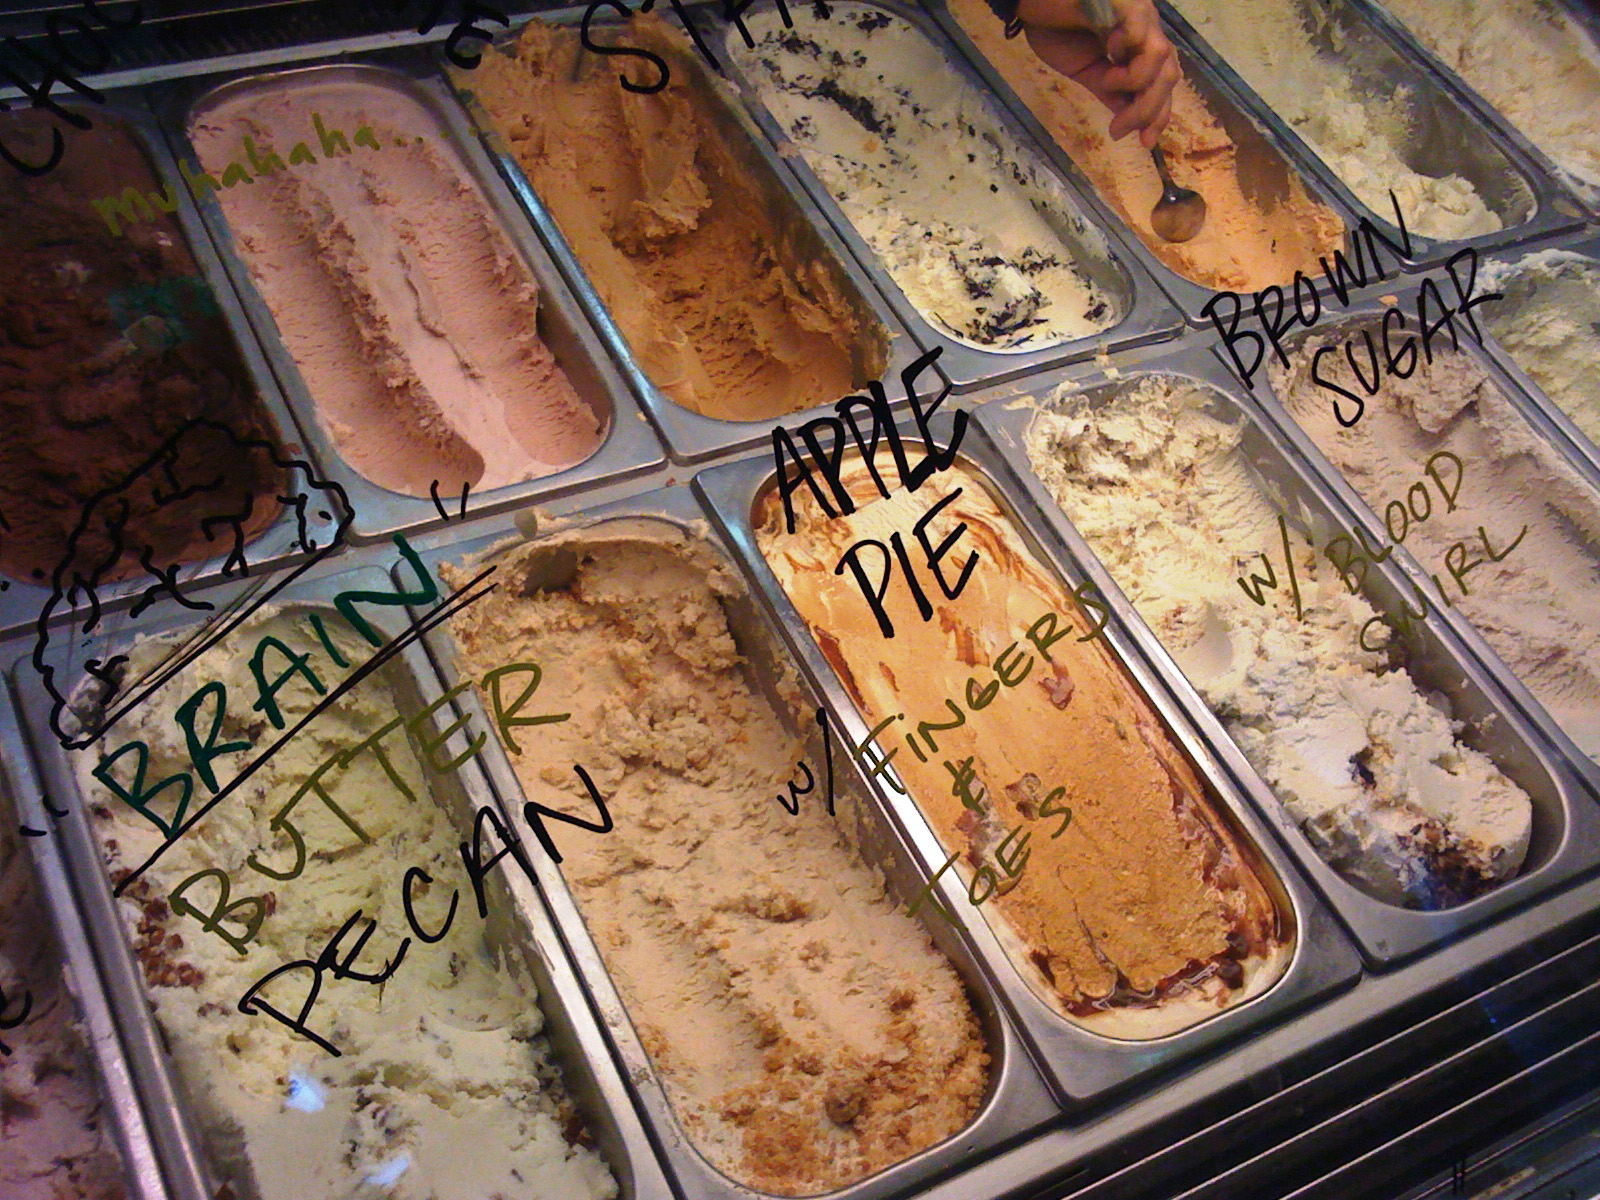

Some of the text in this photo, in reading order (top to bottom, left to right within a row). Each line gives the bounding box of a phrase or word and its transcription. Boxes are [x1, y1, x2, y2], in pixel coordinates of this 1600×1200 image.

[1200, 188, 1412, 389] BROWN
[1311, 248, 1503, 427] SUGAR
[772, 346, 969, 533] APPLE
[1325, 451, 1464, 595] BLOOD
[835, 487, 981, 638] PIE
[92, 533, 438, 839] BRAIN
[168, 662, 571, 955] BUTTER
[906, 787, 1072, 931] TOES
[238, 765, 613, 1056] PECAN
